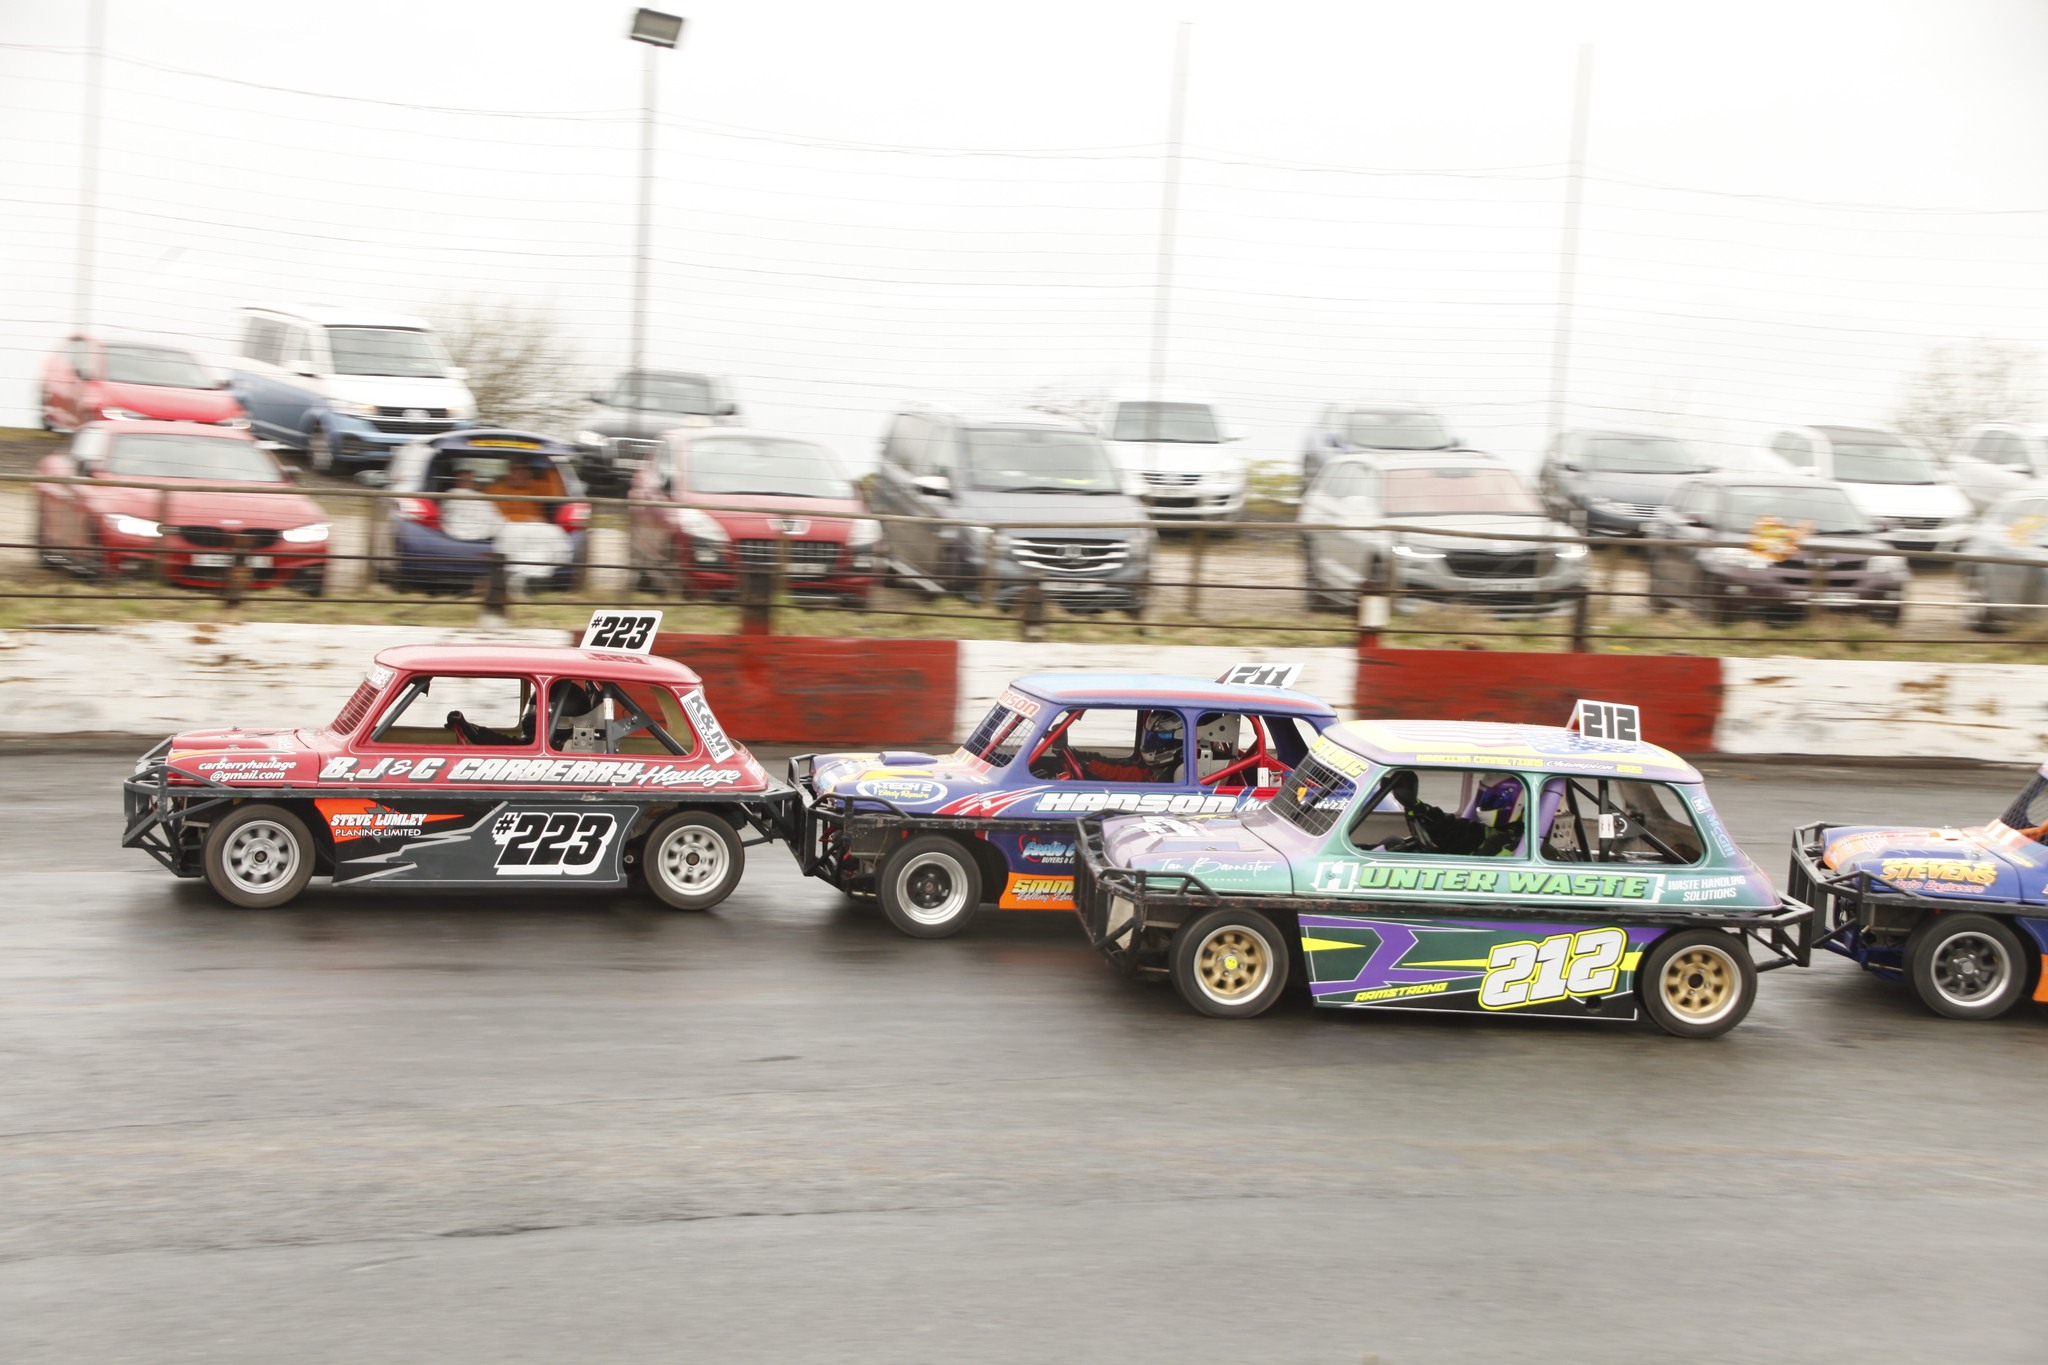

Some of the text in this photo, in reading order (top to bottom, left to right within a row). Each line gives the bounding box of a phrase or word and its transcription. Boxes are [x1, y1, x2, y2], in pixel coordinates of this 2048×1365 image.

[590, 616, 656, 649] #223
[1230, 666, 1292, 686] 711
[1583, 704, 1637, 741] 212
[198, 759, 297, 771] carberryhaulage
[446, 758, 645, 783] CARBERRY
[637, 764, 742, 786] Haulage
[1546, 760, 1615, 770] Champion
[210, 770, 285, 782] @gmail.com
[331, 813, 428, 826] STEVE LUMLEY
[335, 828, 421, 837] PLANING LIMITED
[491, 812, 618, 875] #223
[1668, 875, 1746, 890] WASTE HANDLING
[1880, 863, 1998, 885] STEVENS
[1508, 872, 1648, 898] WASTE
[1683, 887, 1736, 901] SOLUTIONS
[1478, 926, 1629, 1011] 212
[1354, 982, 1448, 1001] ARMSTRONG
